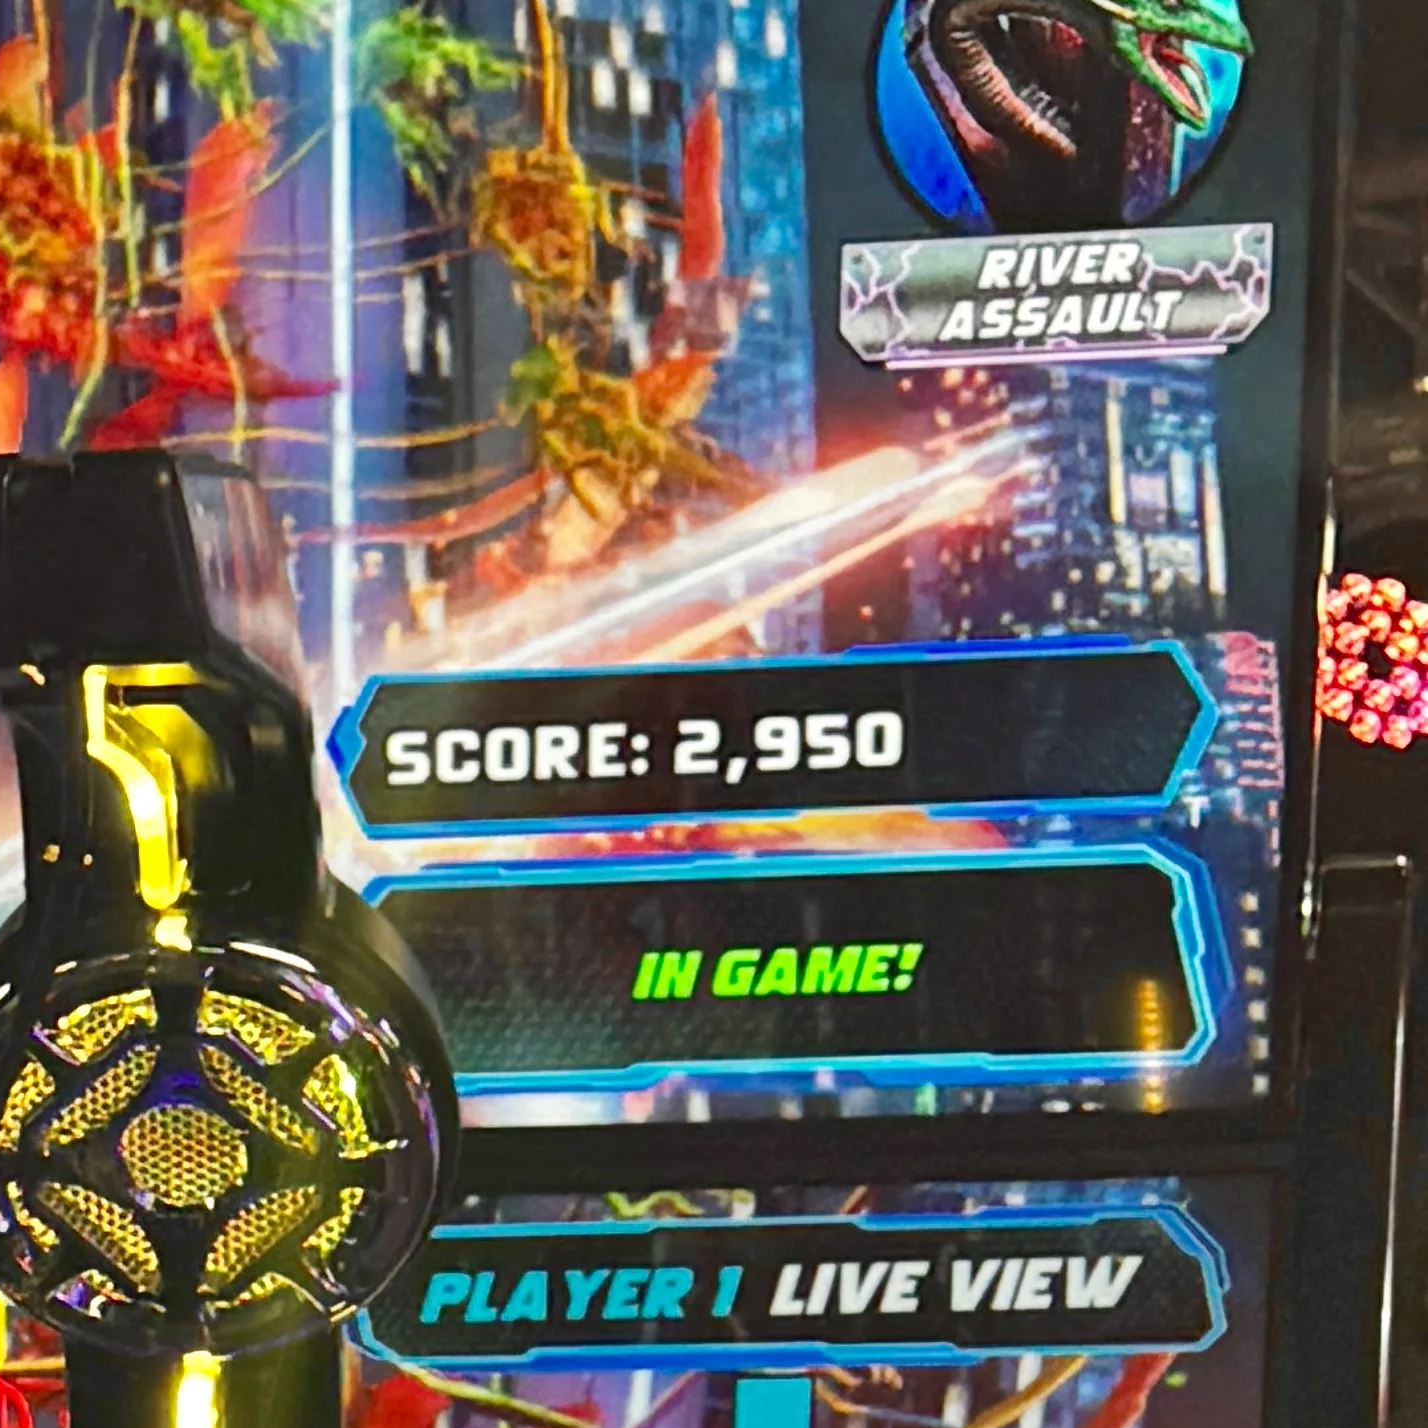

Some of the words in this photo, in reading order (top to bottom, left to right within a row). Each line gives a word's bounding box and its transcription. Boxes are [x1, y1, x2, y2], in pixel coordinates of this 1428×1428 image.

[978, 243, 1142, 290] RIVER
[939, 291, 1183, 341] ASSAULT
[385, 722, 650, 786] SCORE:
[674, 710, 904, 784] 2,950
[632, 950, 703, 999] IN
[712, 943, 923, 995] GAME!
[419, 1267, 695, 1324] PLAYER
[711, 1265, 744, 1318] 1
[769, 1260, 929, 1317] LIVE
[950, 1255, 1143, 1311] VIEW
